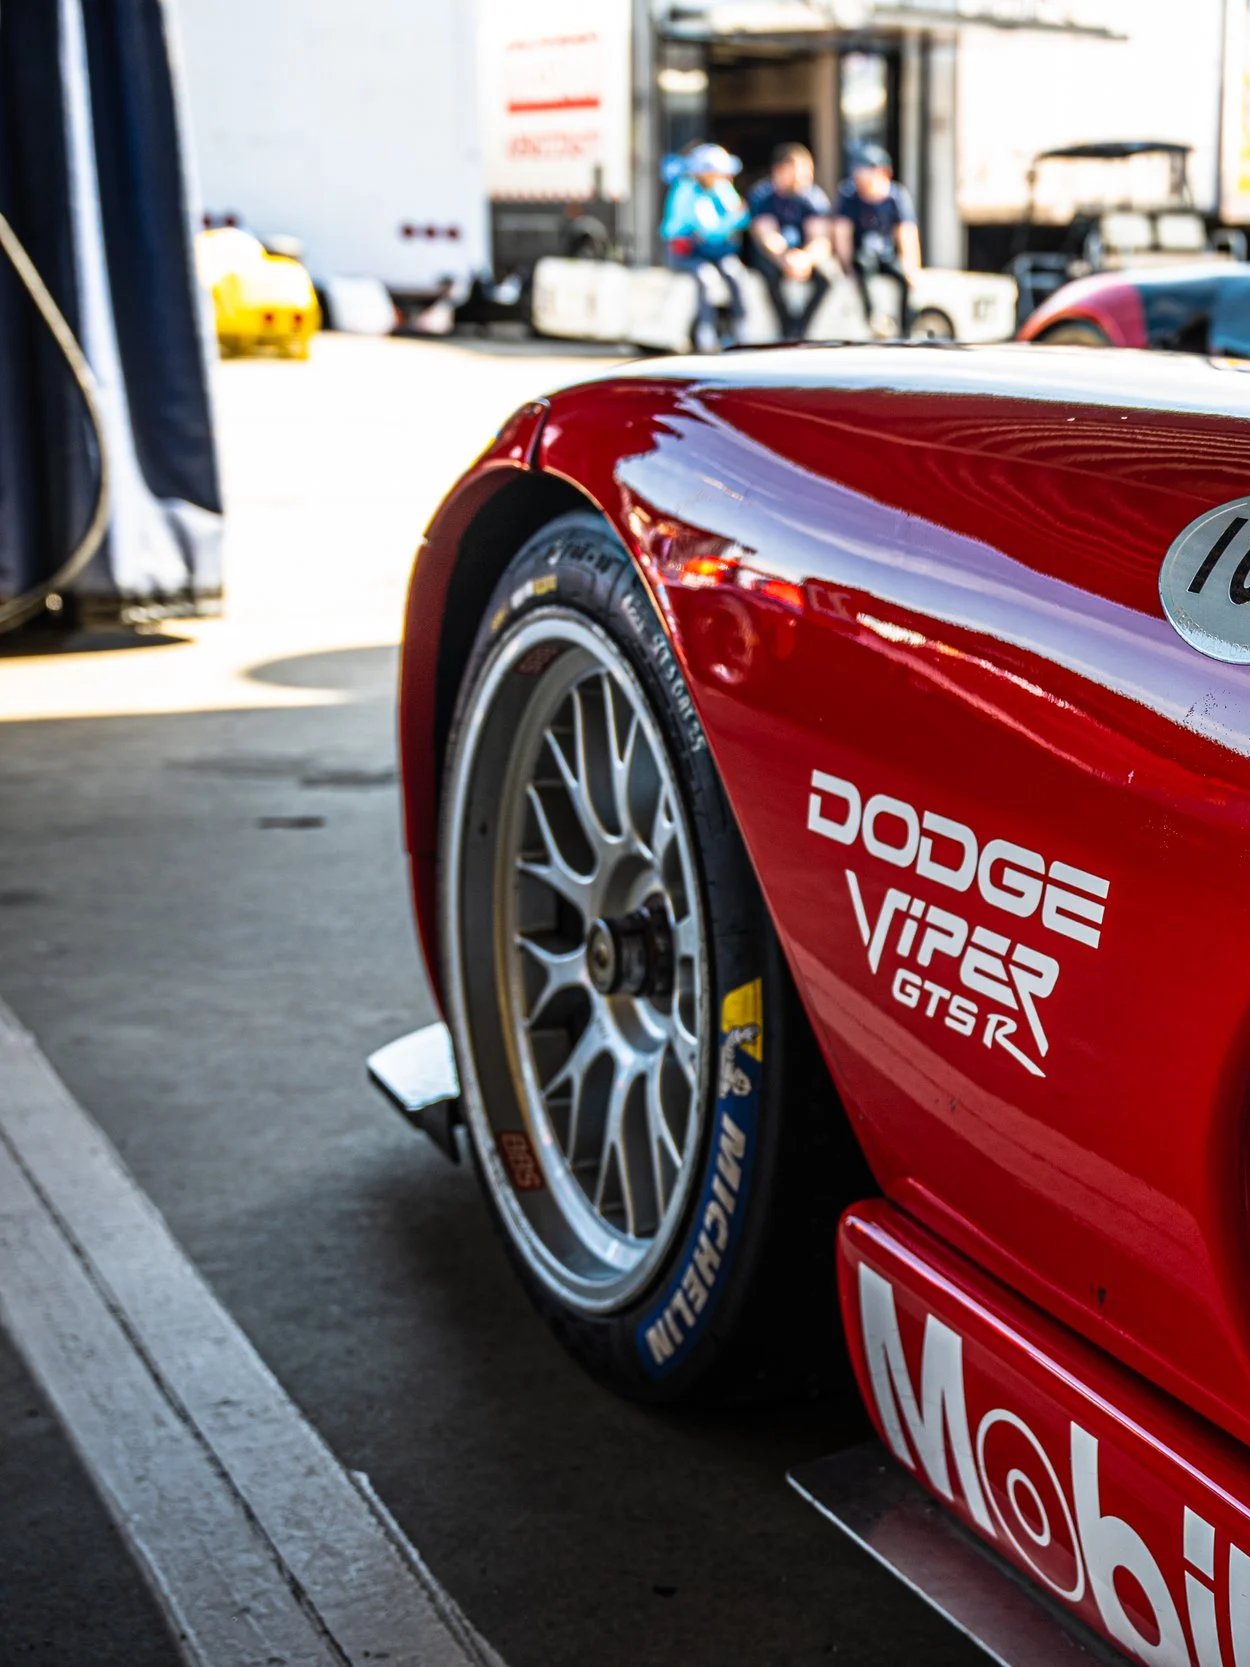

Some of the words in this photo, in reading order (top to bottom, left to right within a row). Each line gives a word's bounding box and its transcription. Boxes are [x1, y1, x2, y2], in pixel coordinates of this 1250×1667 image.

[807, 769, 1110, 949] DODGE
[845, 869, 1060, 1057] VIPER
[646, 1113, 747, 1365] MICHELIN
